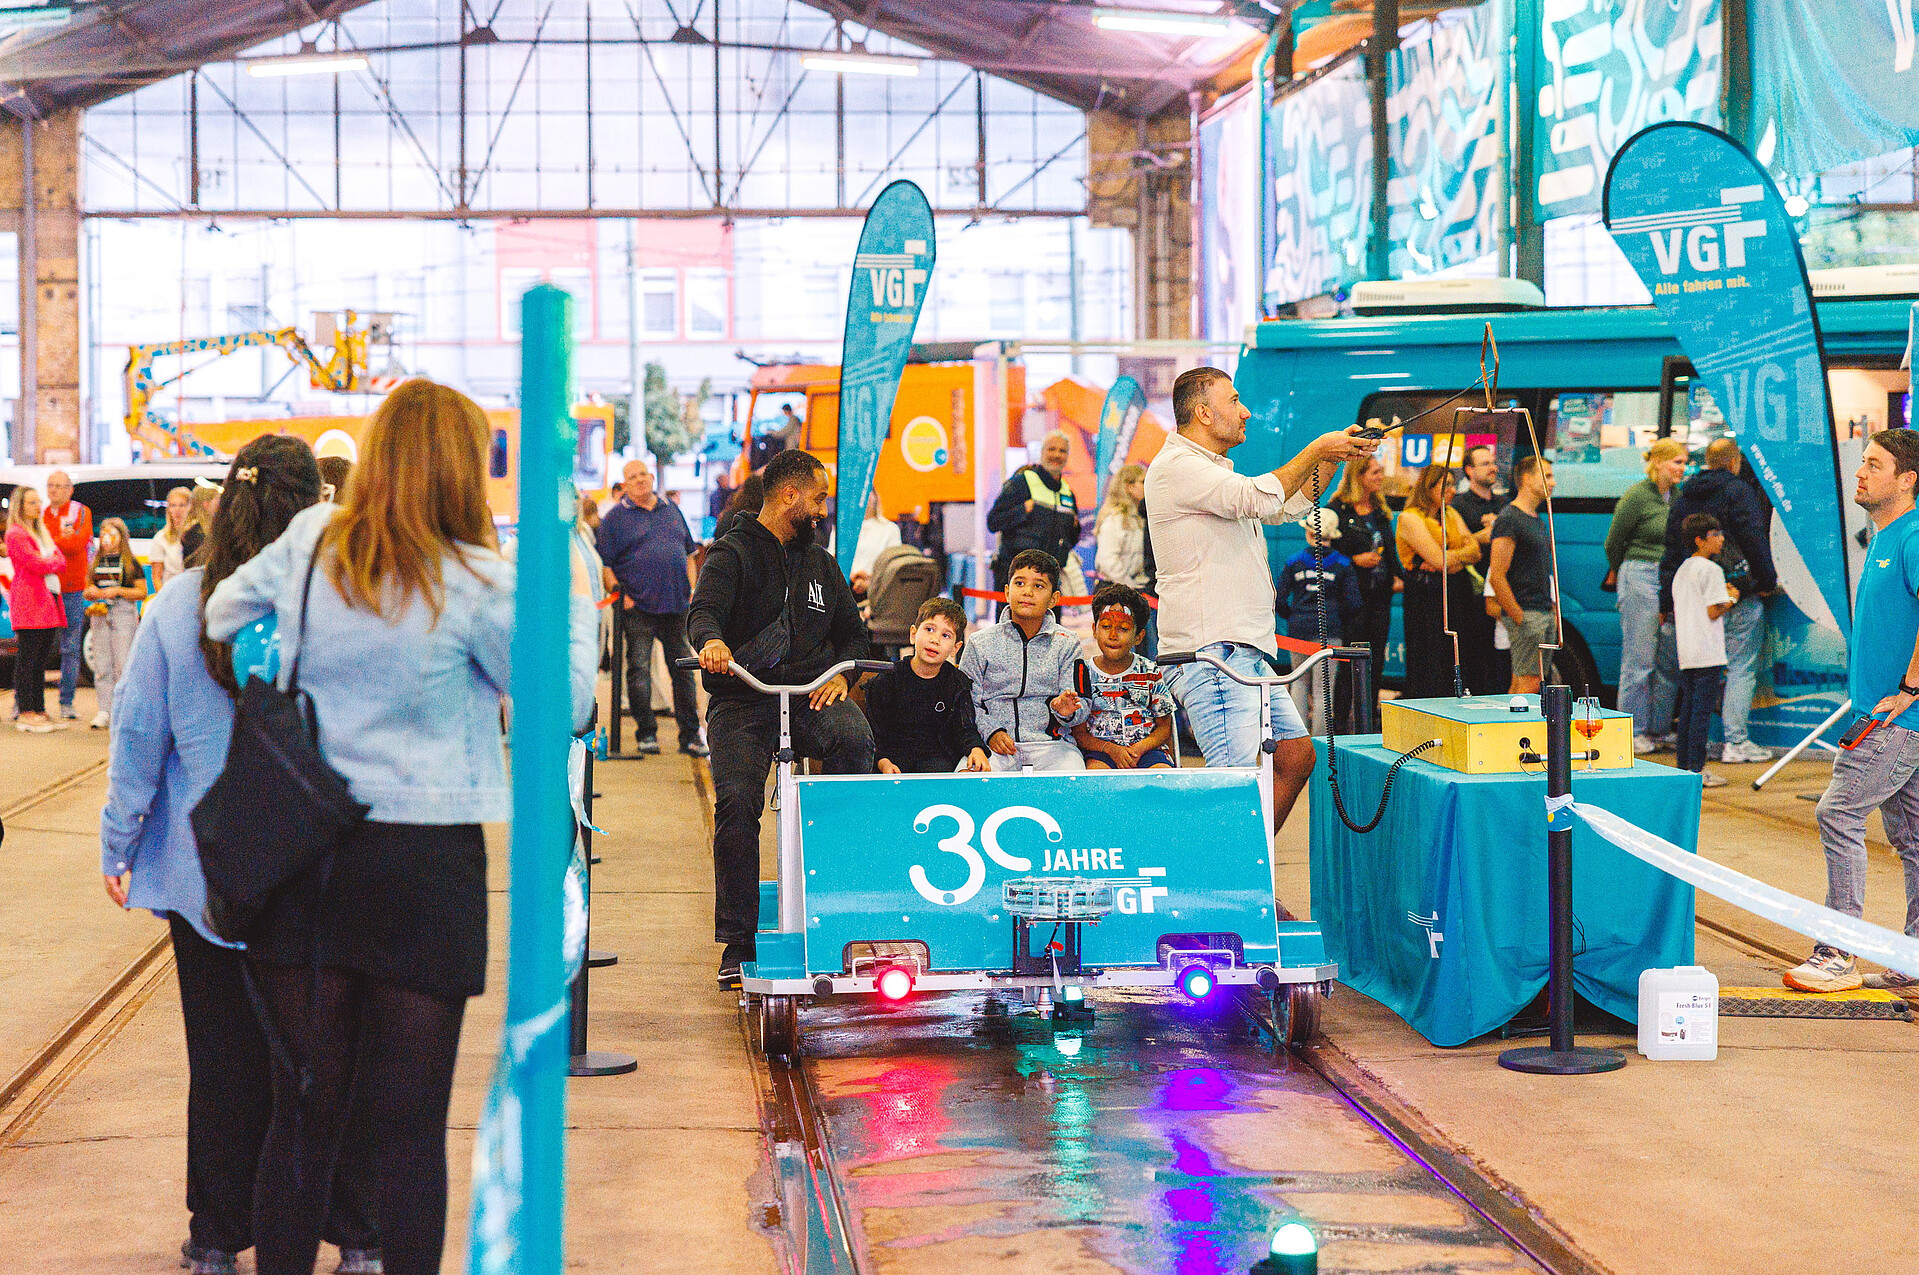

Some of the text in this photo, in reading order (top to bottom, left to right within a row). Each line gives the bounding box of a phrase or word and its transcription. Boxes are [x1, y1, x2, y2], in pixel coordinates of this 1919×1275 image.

[1649, 186, 1768, 276] VGF
[870, 240, 927, 308] VGF
[1655, 281, 1680, 296] Alle
[1683, 278, 1723, 293] fahren
[1405, 438, 1429, 464] U
[1042, 847, 1125, 872] JAHRE
